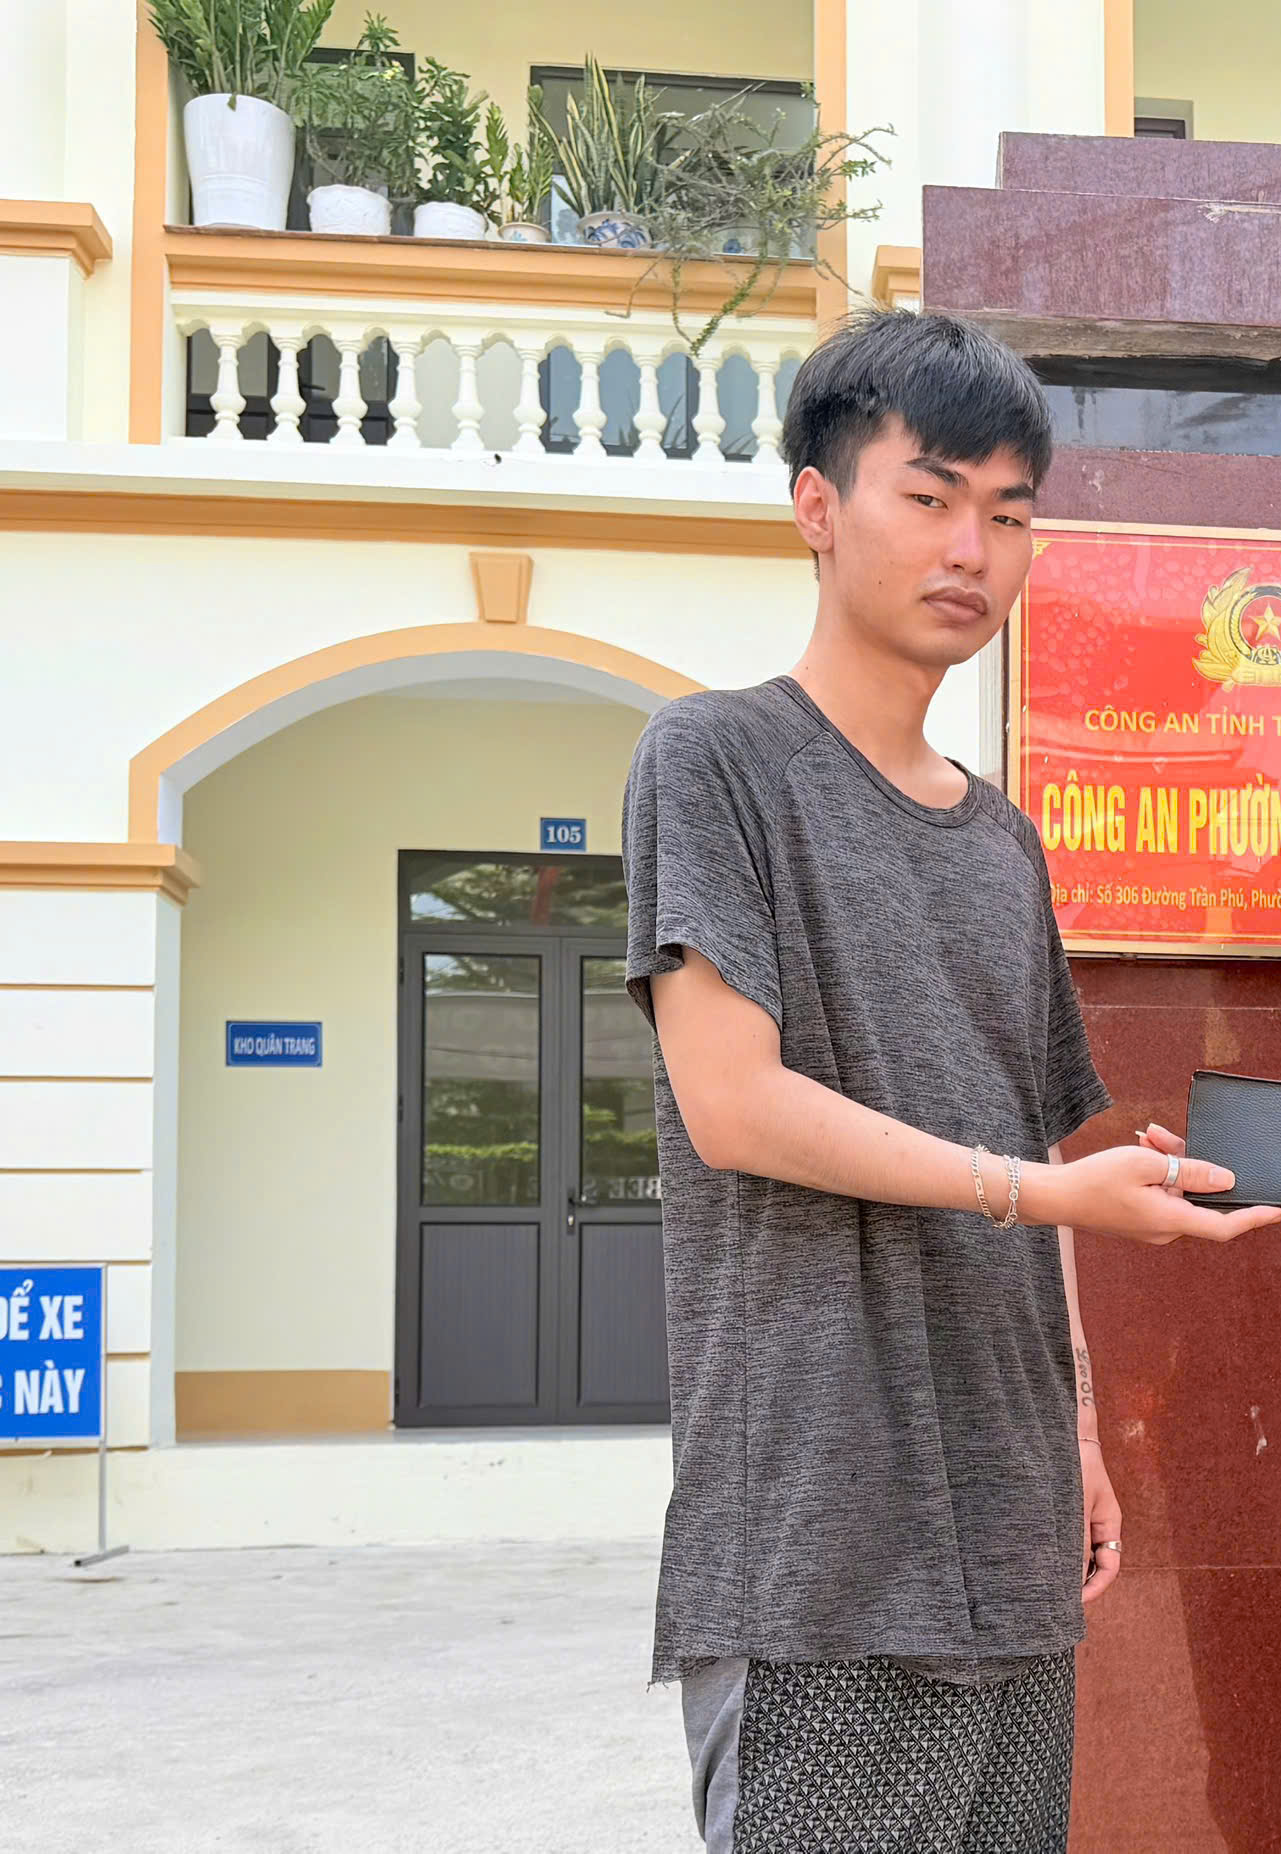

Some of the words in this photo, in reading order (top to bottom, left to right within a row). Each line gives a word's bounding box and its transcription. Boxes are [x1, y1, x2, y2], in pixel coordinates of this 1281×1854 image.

[1085, 705, 1156, 733] CÔNG
[1164, 713, 1199, 734] AN
[1206, 705, 1265, 737] TỈNH
[1042, 769, 1126, 852] CÔNG
[1136, 786, 1178, 854] AN
[546, 825, 582, 844] 105
[1097, 883, 1113, 904] Số
[1116, 885, 1139, 905] 306
[1142, 885, 1187, 911] Đường
[1190, 885, 1217, 908] Trần
[1220, 887, 1248, 911] Phú,
[233, 1037, 254, 1056] KHO
[284, 1037, 316, 1056] TRANG
[39, 1295, 85, 1341] XE
[13, 1359, 86, 1415] NÀY
